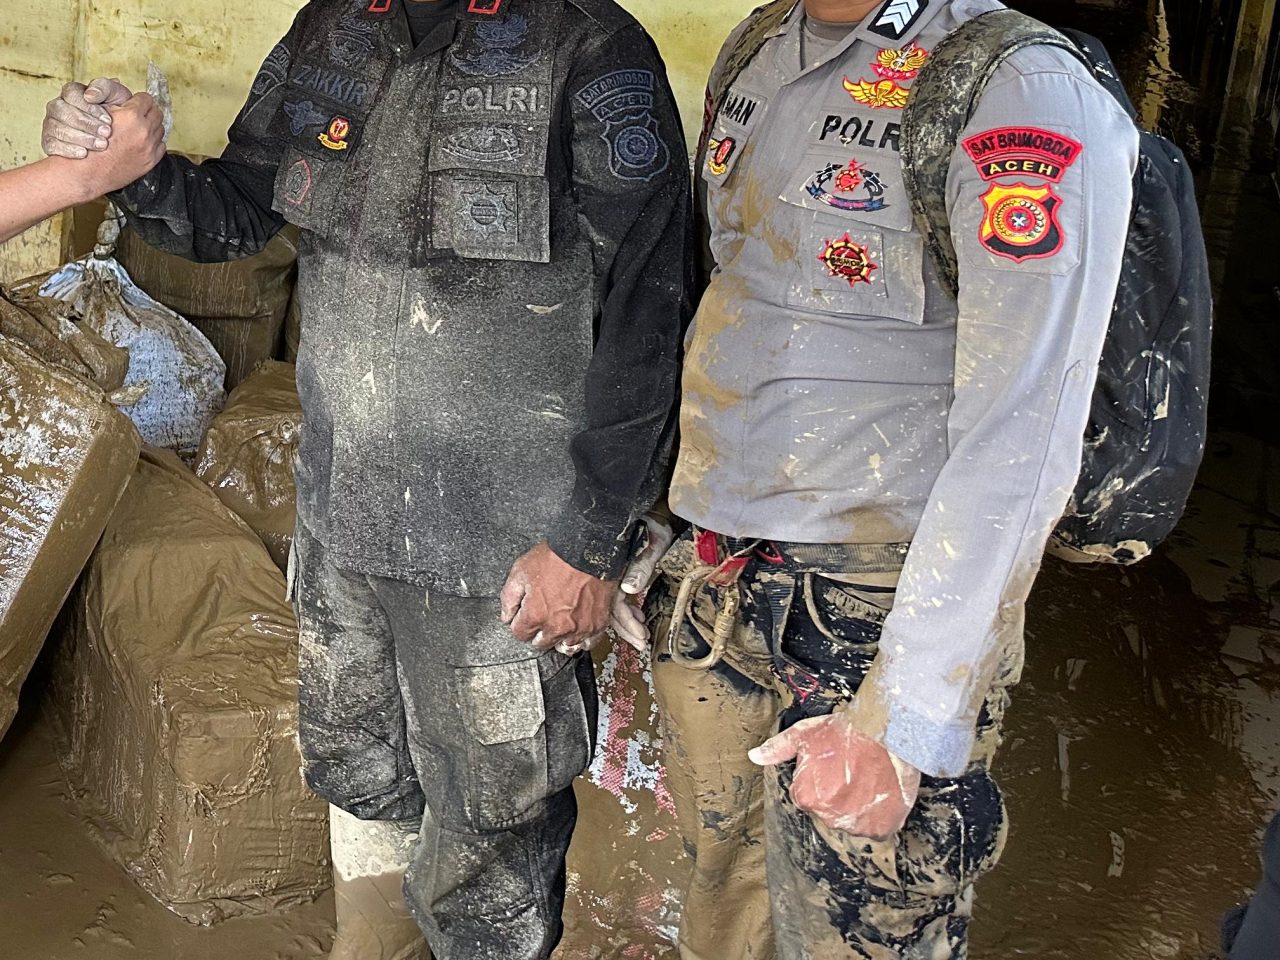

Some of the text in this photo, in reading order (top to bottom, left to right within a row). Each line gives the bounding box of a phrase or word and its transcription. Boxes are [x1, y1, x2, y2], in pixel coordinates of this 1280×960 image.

[441, 84, 538, 113] POLRI
[819, 115, 902, 152] POLR
[970, 131, 1072, 160] SAT BRIMOBDA
[989, 160, 1053, 175] ACEH
